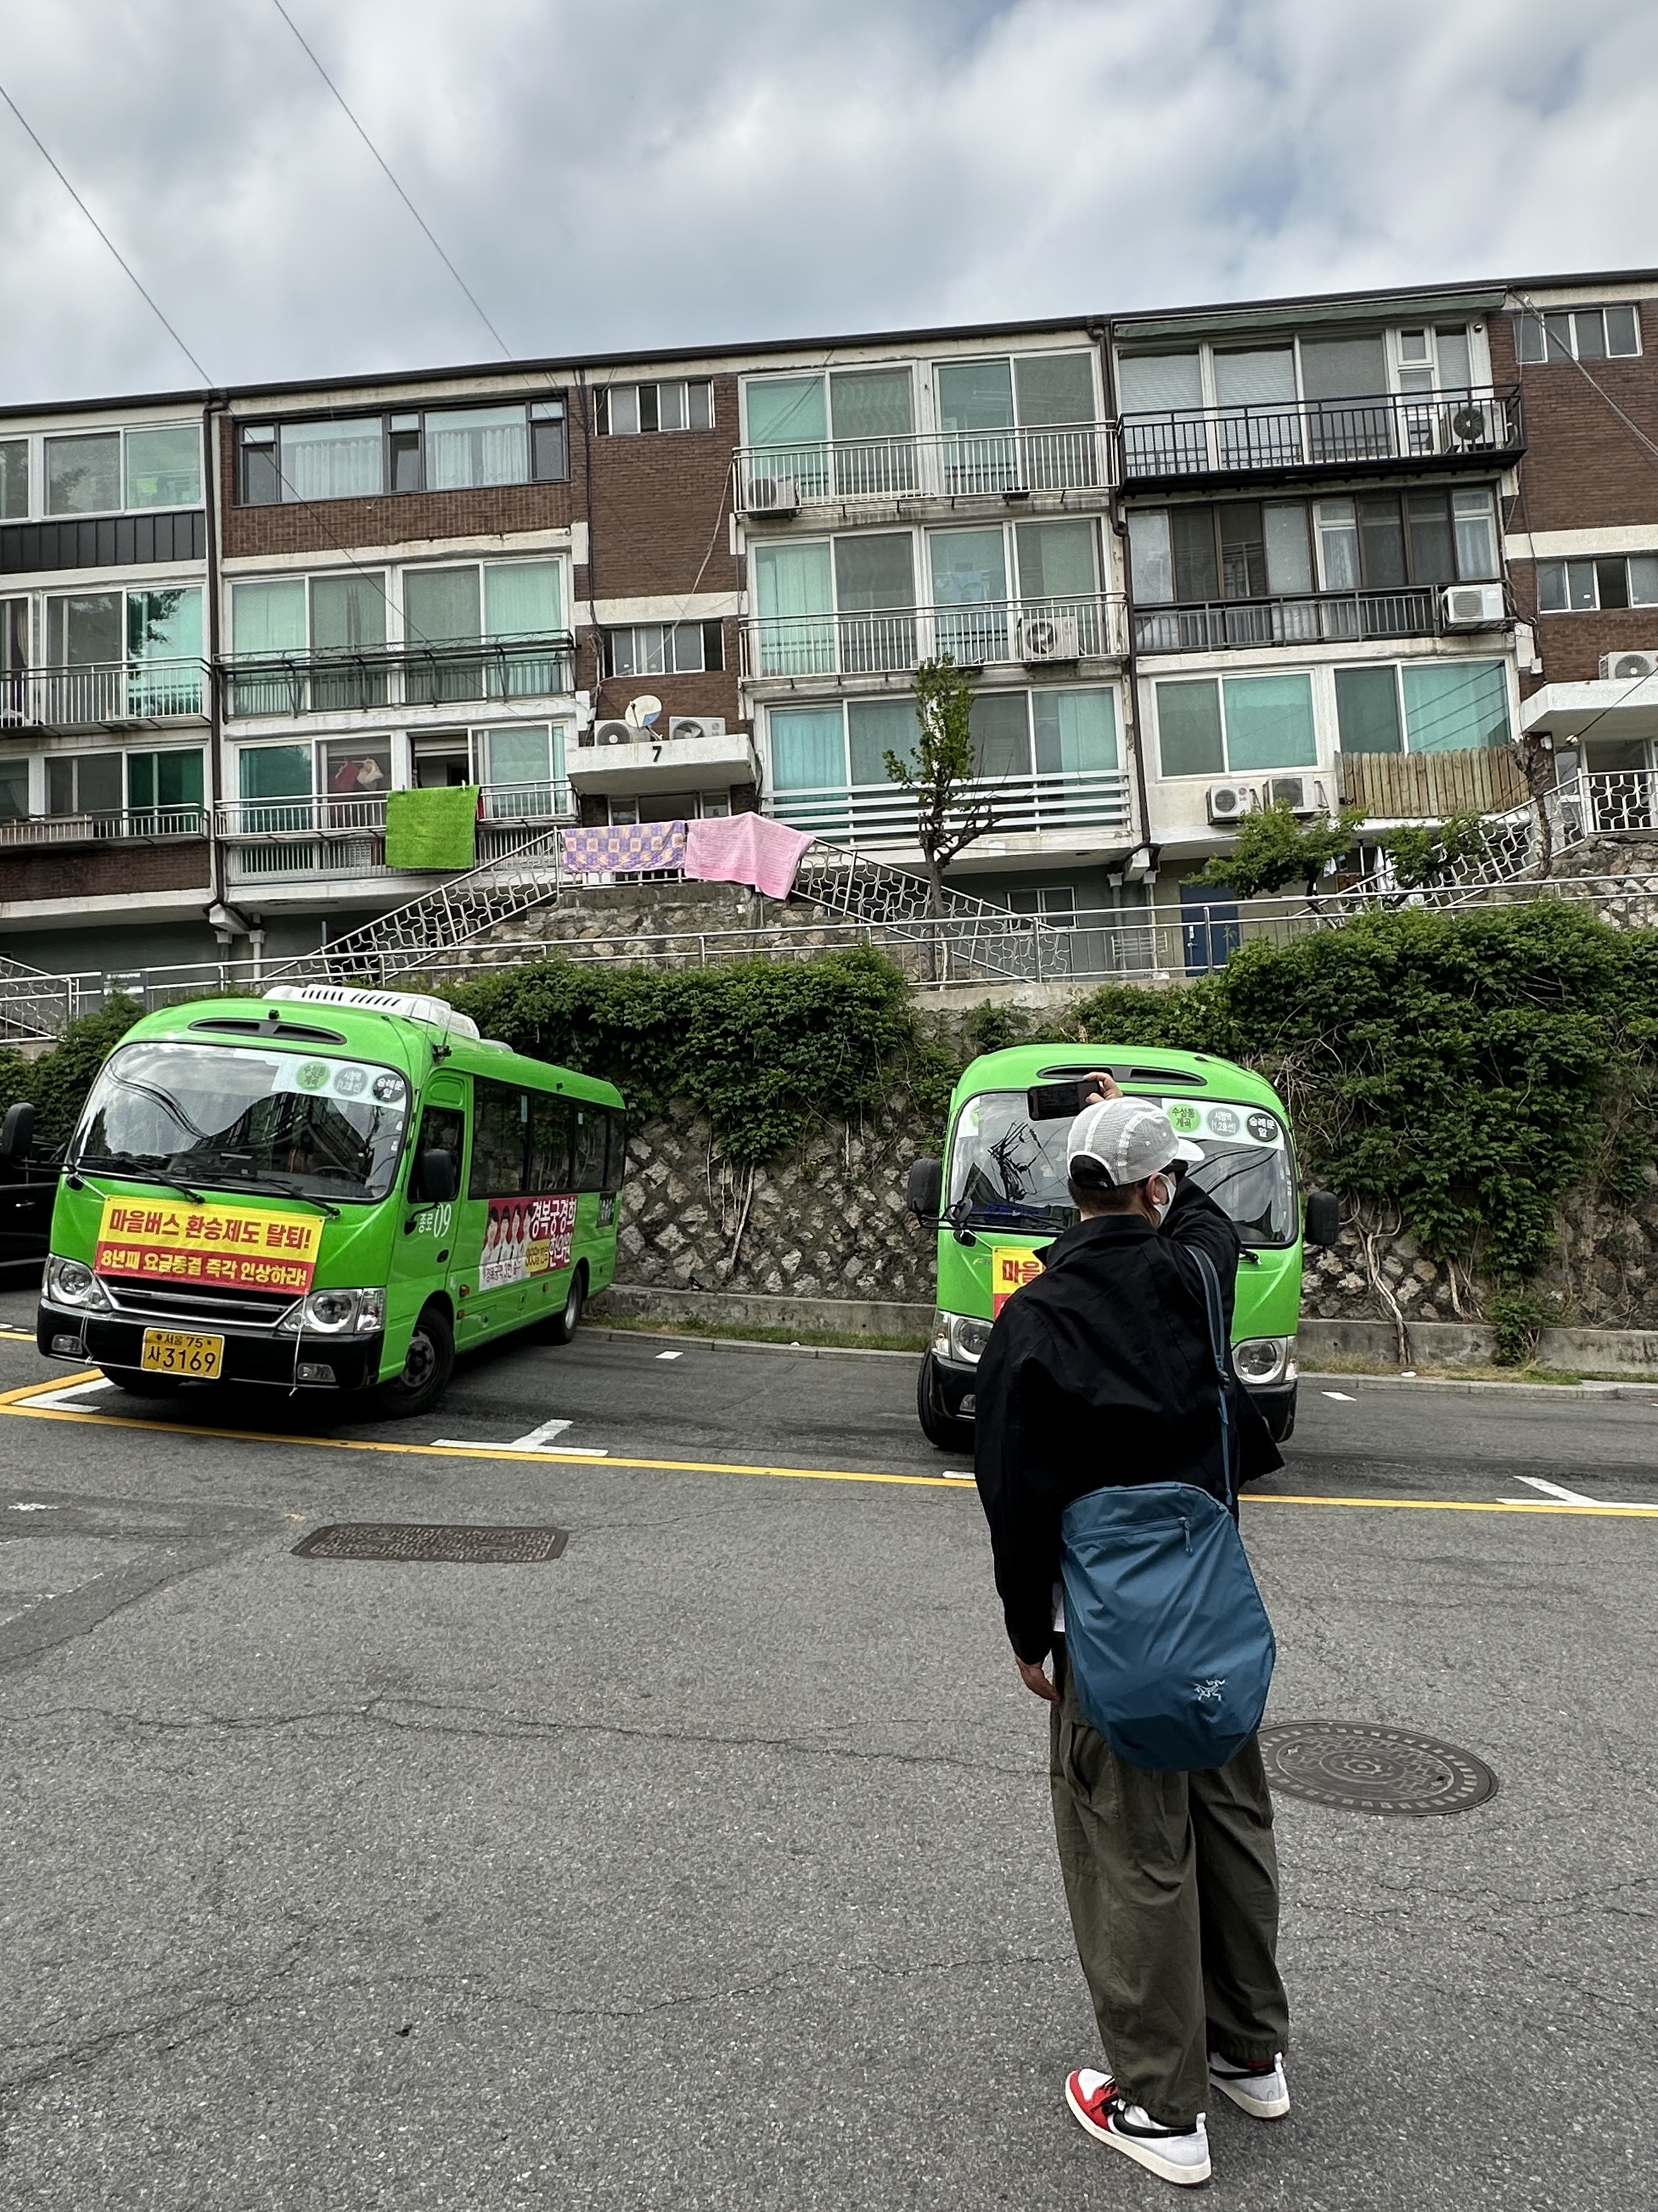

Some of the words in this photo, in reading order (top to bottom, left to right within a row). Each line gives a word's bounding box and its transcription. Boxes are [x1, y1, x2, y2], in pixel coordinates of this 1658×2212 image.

[652, 746, 662, 763] 7
[377, 1078, 404, 1091] 숭례문
[383, 1088, 393, 1099] 앞
[1172, 1106, 1195, 1117] 수성동
[1176, 1117, 1191, 1129] 계곡
[1249, 1117, 1275, 1129] 숭례문
[1258, 1128, 1267, 1138] 앞
[419, 1213, 434, 1234] 종로
[434, 1203, 452, 1238] 09
[109, 1208, 181, 1235] 마을버스
[185, 1215, 261, 1244] 환승제도
[266, 1223, 312, 1249] 탈퇴!
[143, 1252, 202, 1275] 요금동결
[205, 1258, 239, 1279] 즉각
[240, 1262, 306, 1286] 인상하라!
[1002, 1260, 1047, 1283] 마을
[165, 1334, 183, 1346] 서울
[186, 1337, 204, 1348] 75
[148, 1346, 216, 1372] 사3169
